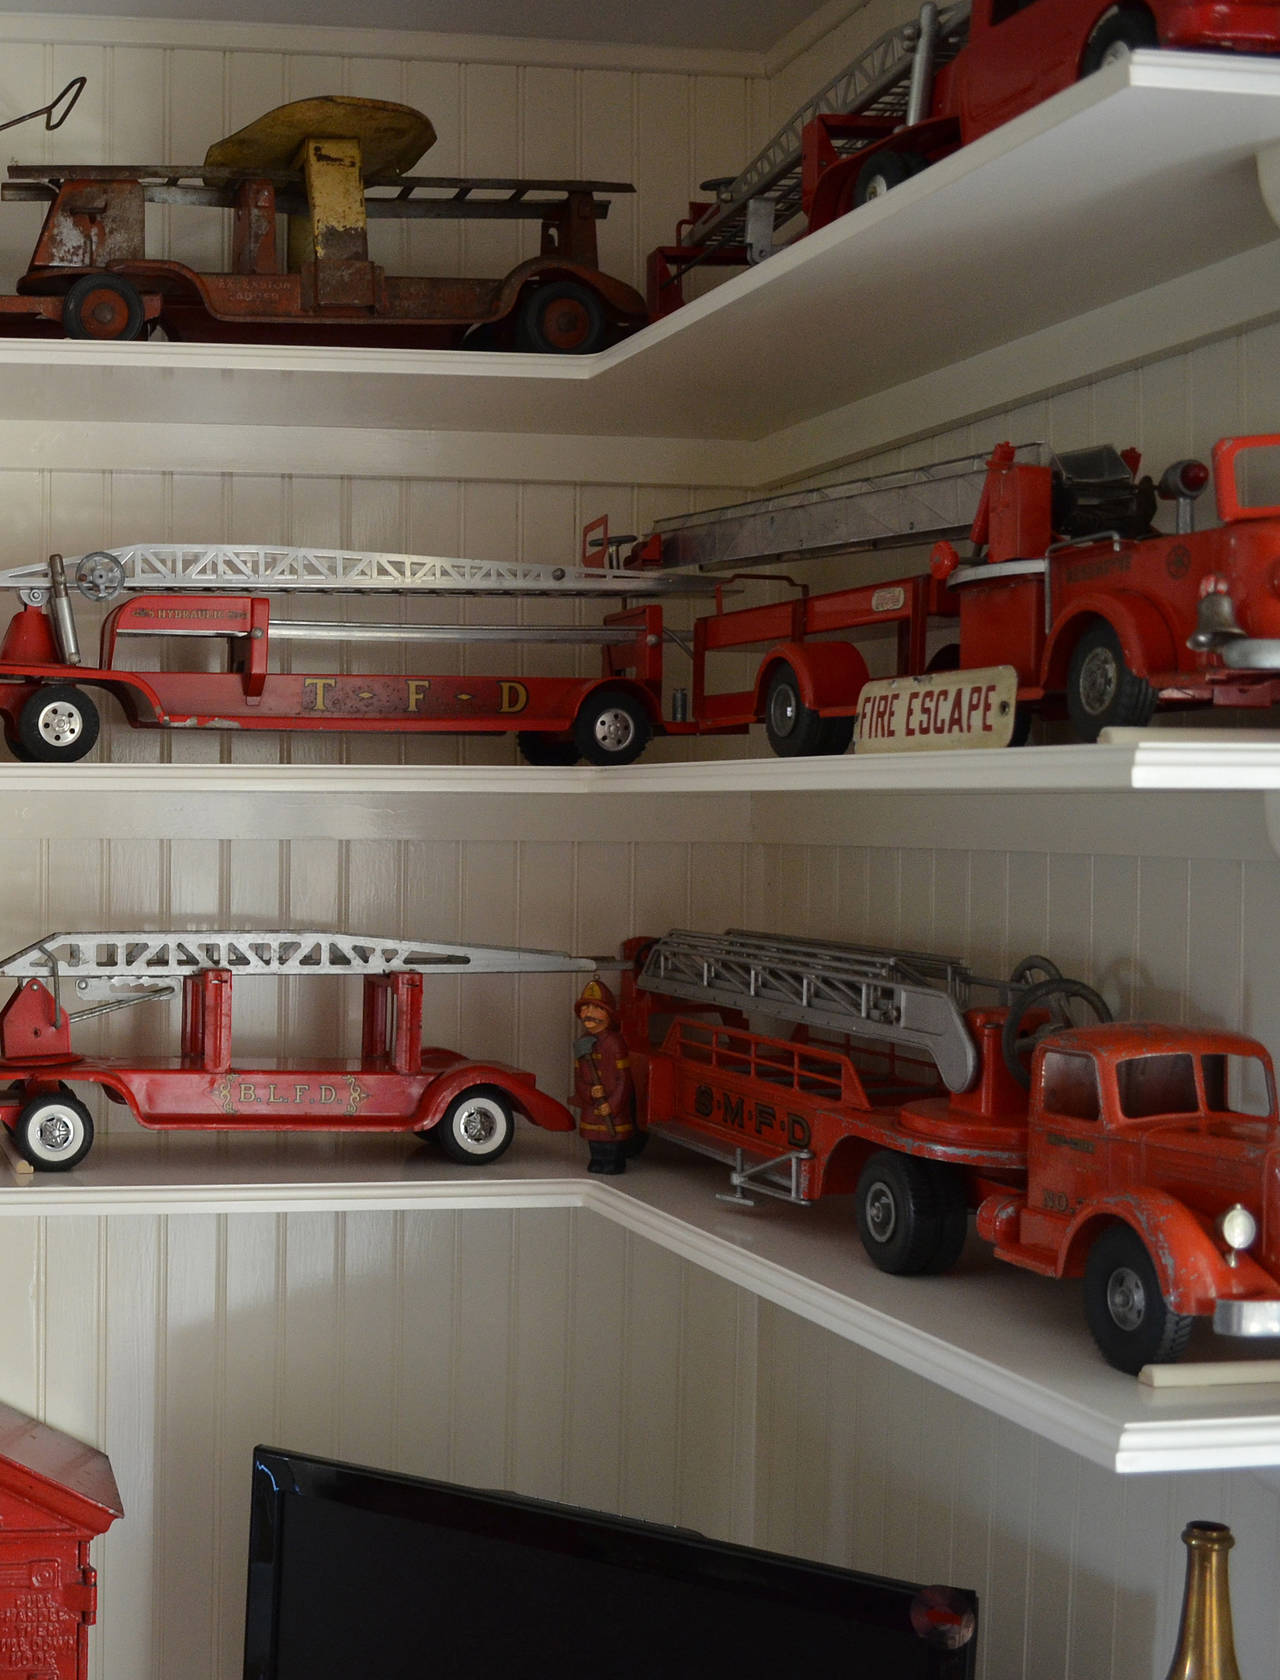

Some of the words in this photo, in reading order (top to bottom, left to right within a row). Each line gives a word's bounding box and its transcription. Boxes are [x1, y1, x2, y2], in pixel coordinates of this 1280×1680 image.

[157, 609, 224, 620] HYDRAULIC
[859, 693, 900, 739] FIRE
[905, 685, 997, 737] ESCAPE
